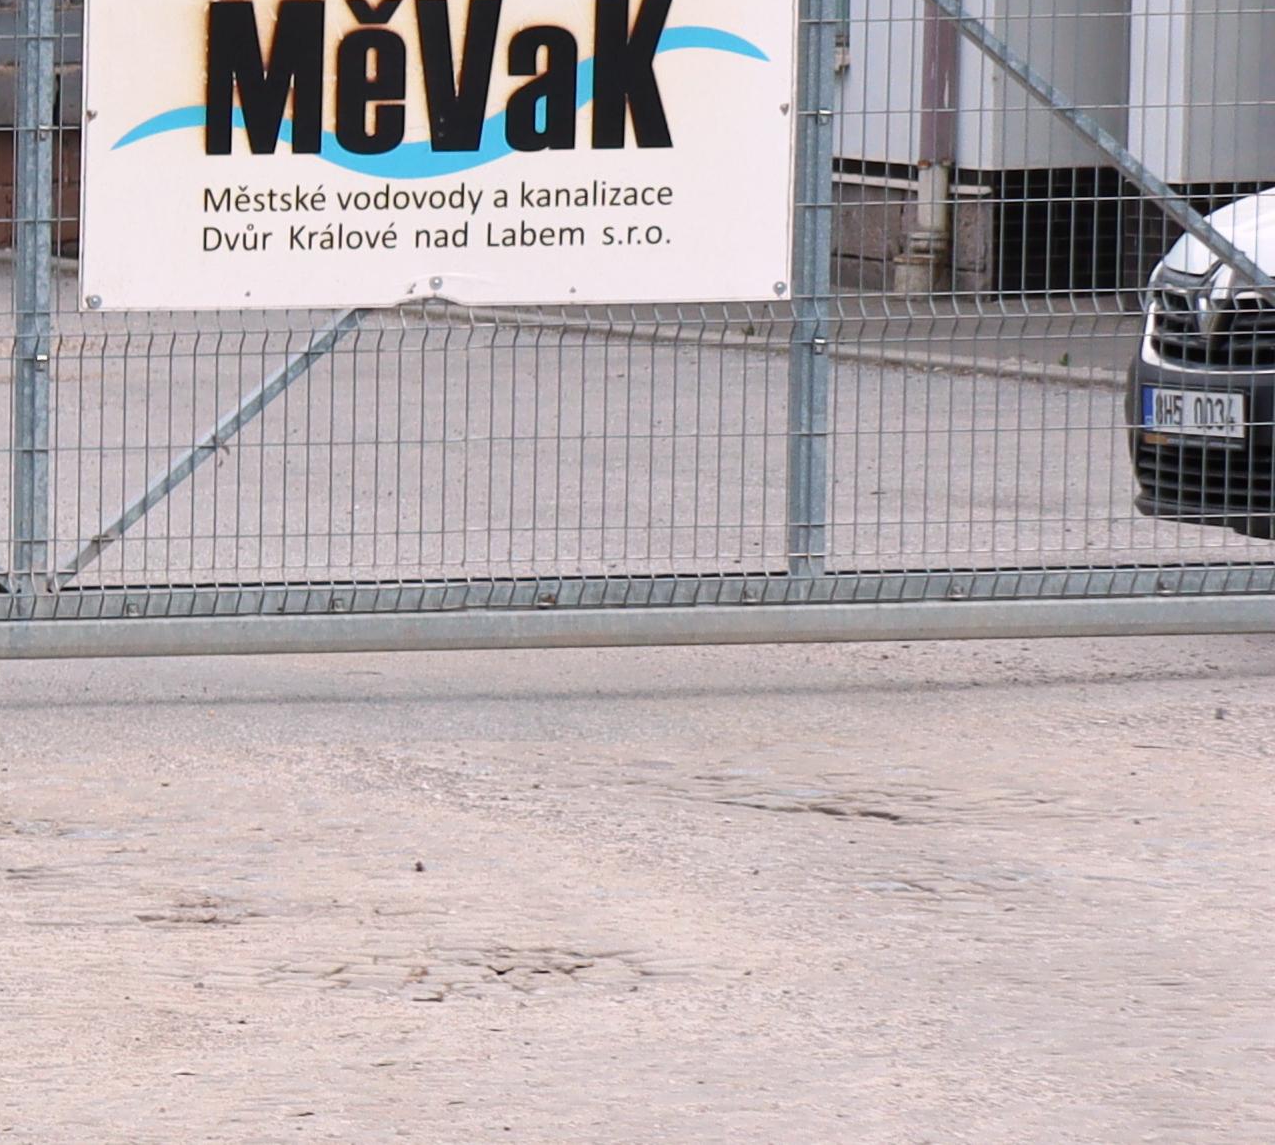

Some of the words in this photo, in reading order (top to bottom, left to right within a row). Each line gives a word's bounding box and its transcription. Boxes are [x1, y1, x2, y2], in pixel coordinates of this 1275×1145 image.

[203, 184, 326, 213] Městské
[337, 183, 483, 215] vodovody
[493, 188, 508, 208] a
[520, 180, 673, 208] kanalizace
[203, 223, 273, 251] Dvůr
[289, 222, 398, 251] Králové
[414, 221, 469, 249] nad
[486, 220, 585, 248] Labem
[602, 224, 672, 246] s.r.o.
